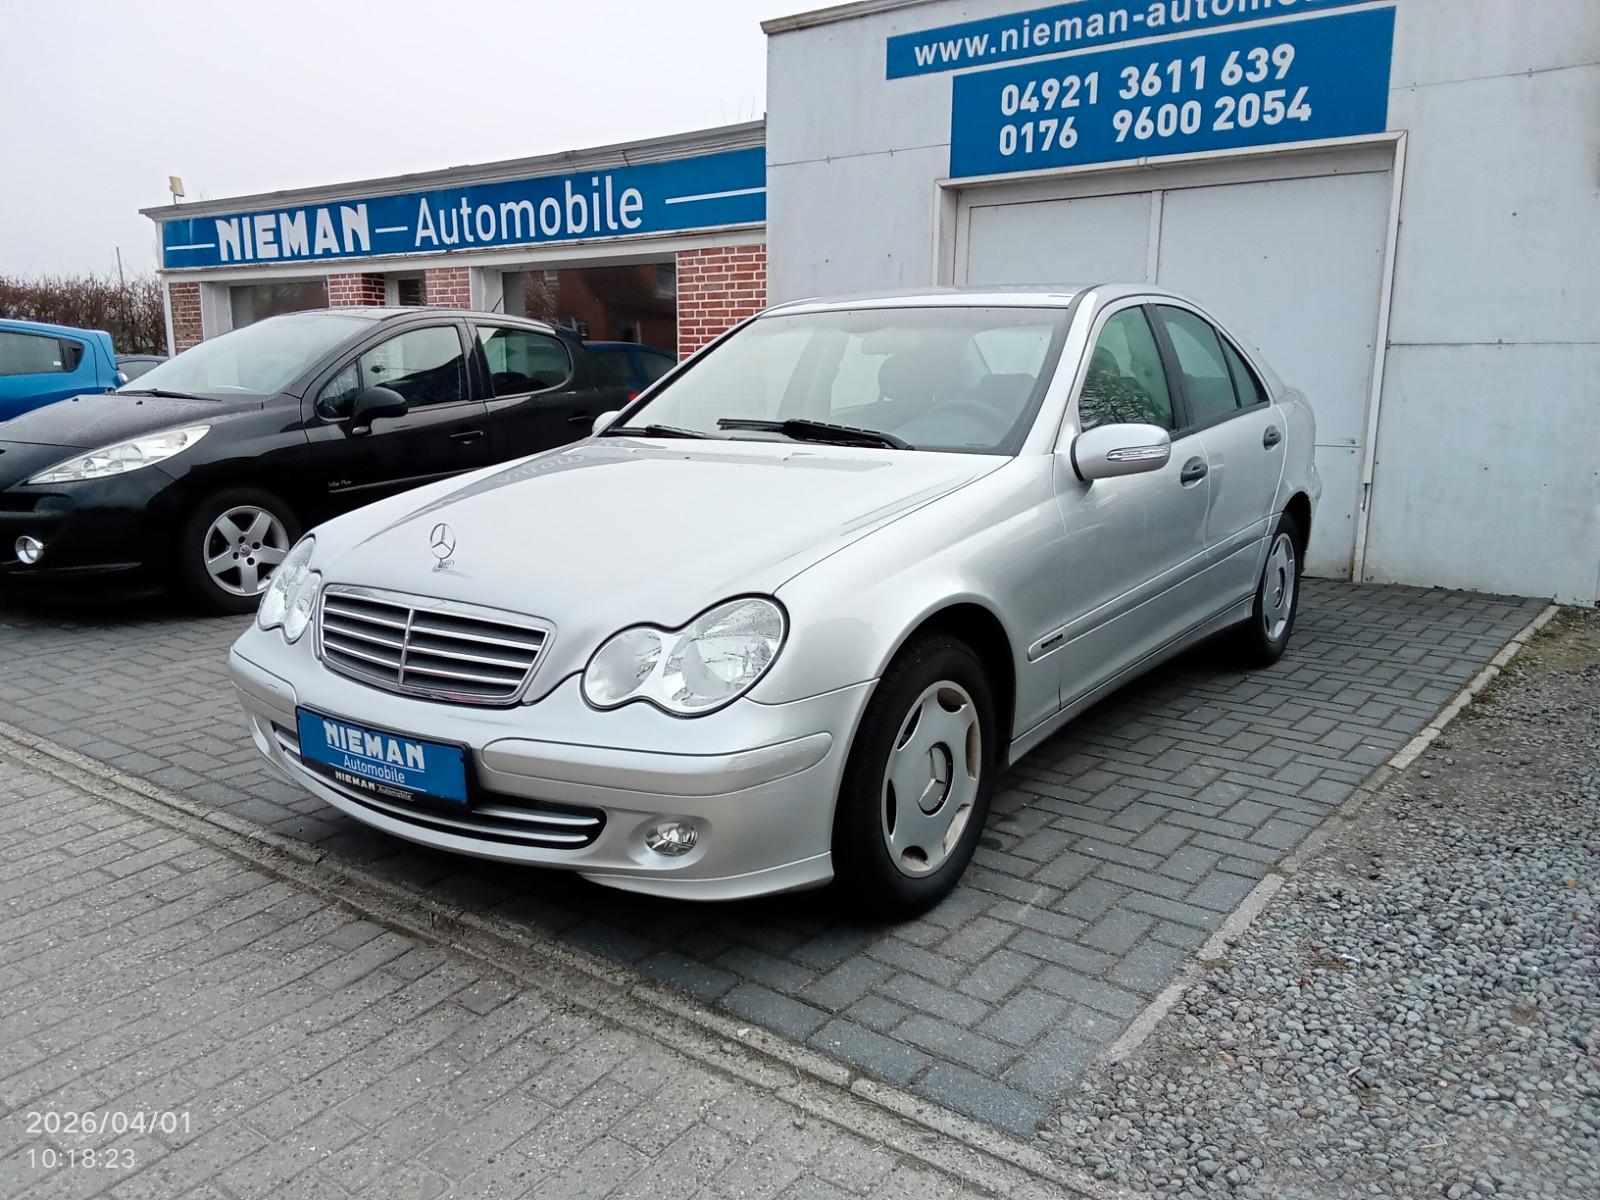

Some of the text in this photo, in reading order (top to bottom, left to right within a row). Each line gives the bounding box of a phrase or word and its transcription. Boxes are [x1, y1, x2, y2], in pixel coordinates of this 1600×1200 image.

[914, 0, 1312, 67] www.nieman-auto
[1001, 43, 1295, 116] 04921 3611 639
[999, 86, 1312, 156] 0176 9600 2054
[215, 175, 643, 261] NIEMAN Automobile
[323, 720, 425, 770] NIEMAN
[343, 755, 405, 784] Automobile
[335, 771, 376, 791] NIEMAN
